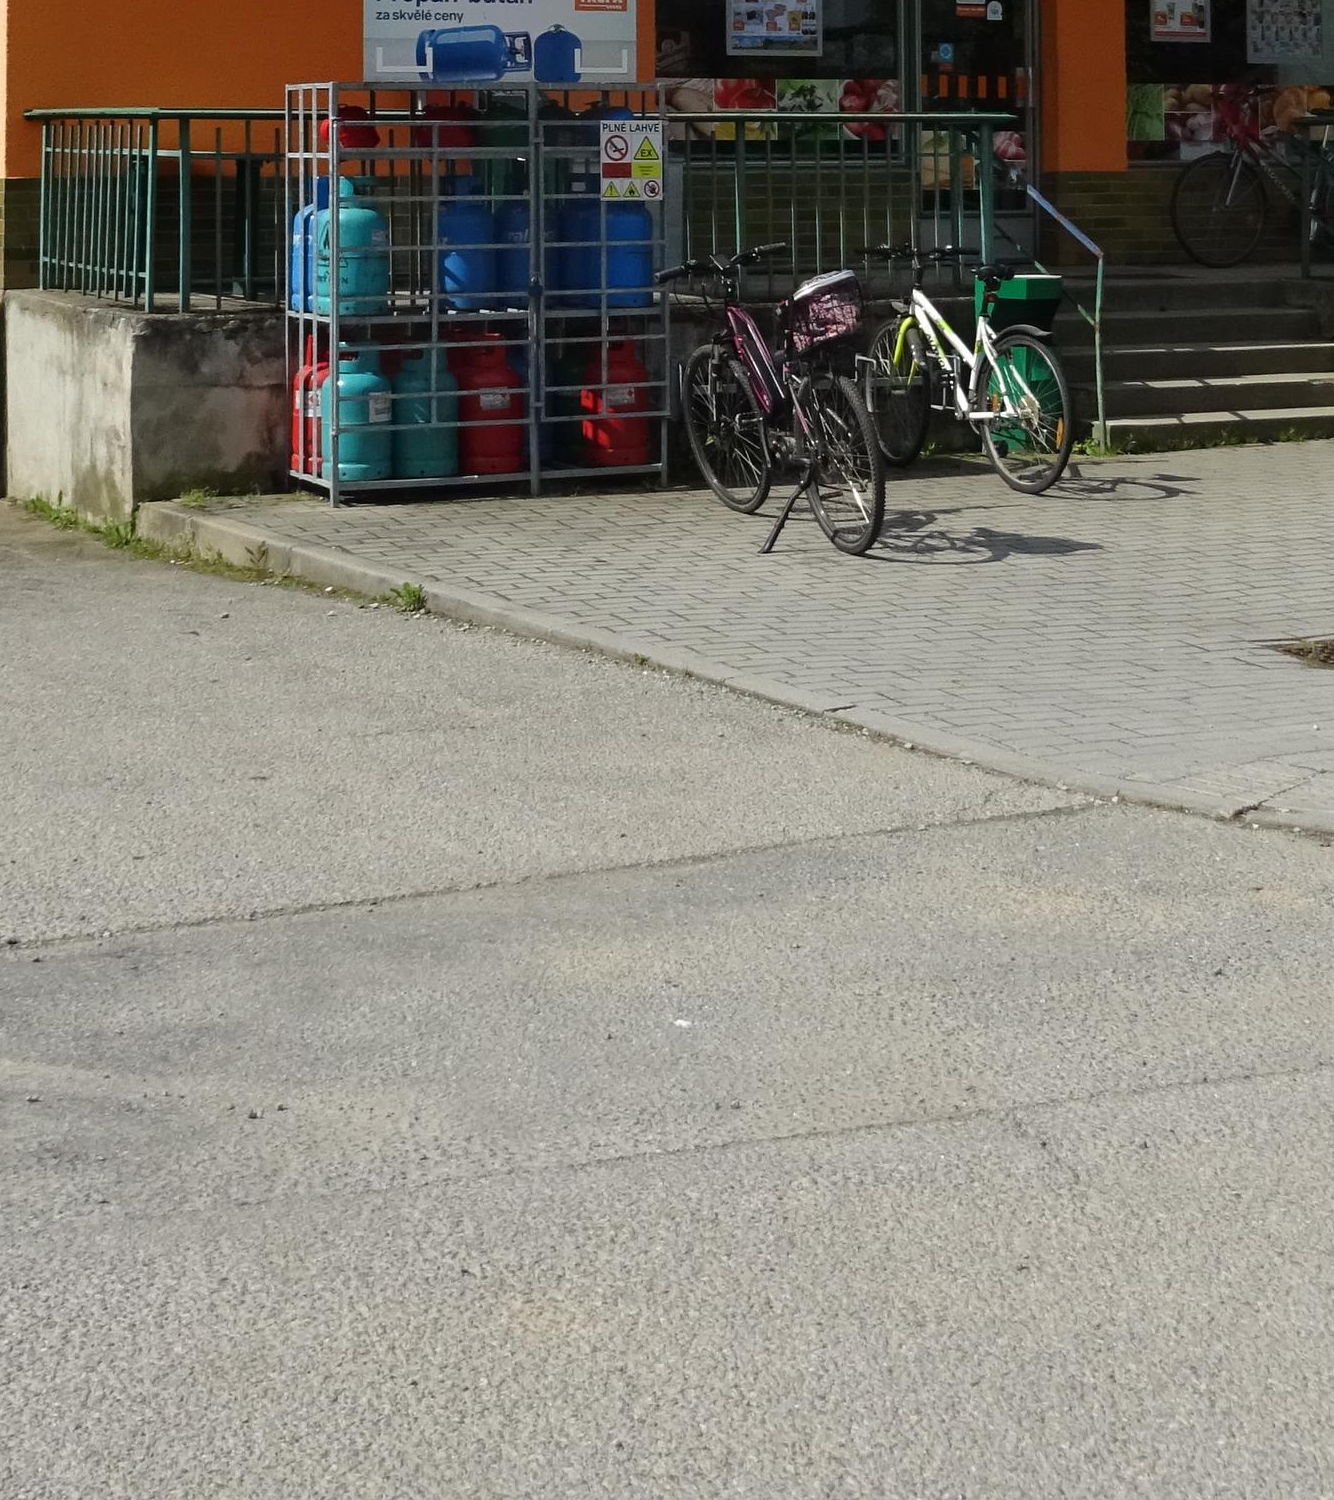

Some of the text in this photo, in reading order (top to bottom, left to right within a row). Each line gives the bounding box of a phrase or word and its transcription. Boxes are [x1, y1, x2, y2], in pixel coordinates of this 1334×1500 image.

[375, 9, 464, 24] za skvělé ceny
[602, 122, 660, 133] PLNÉ LAHVE
[640, 148, 653, 157] EX
